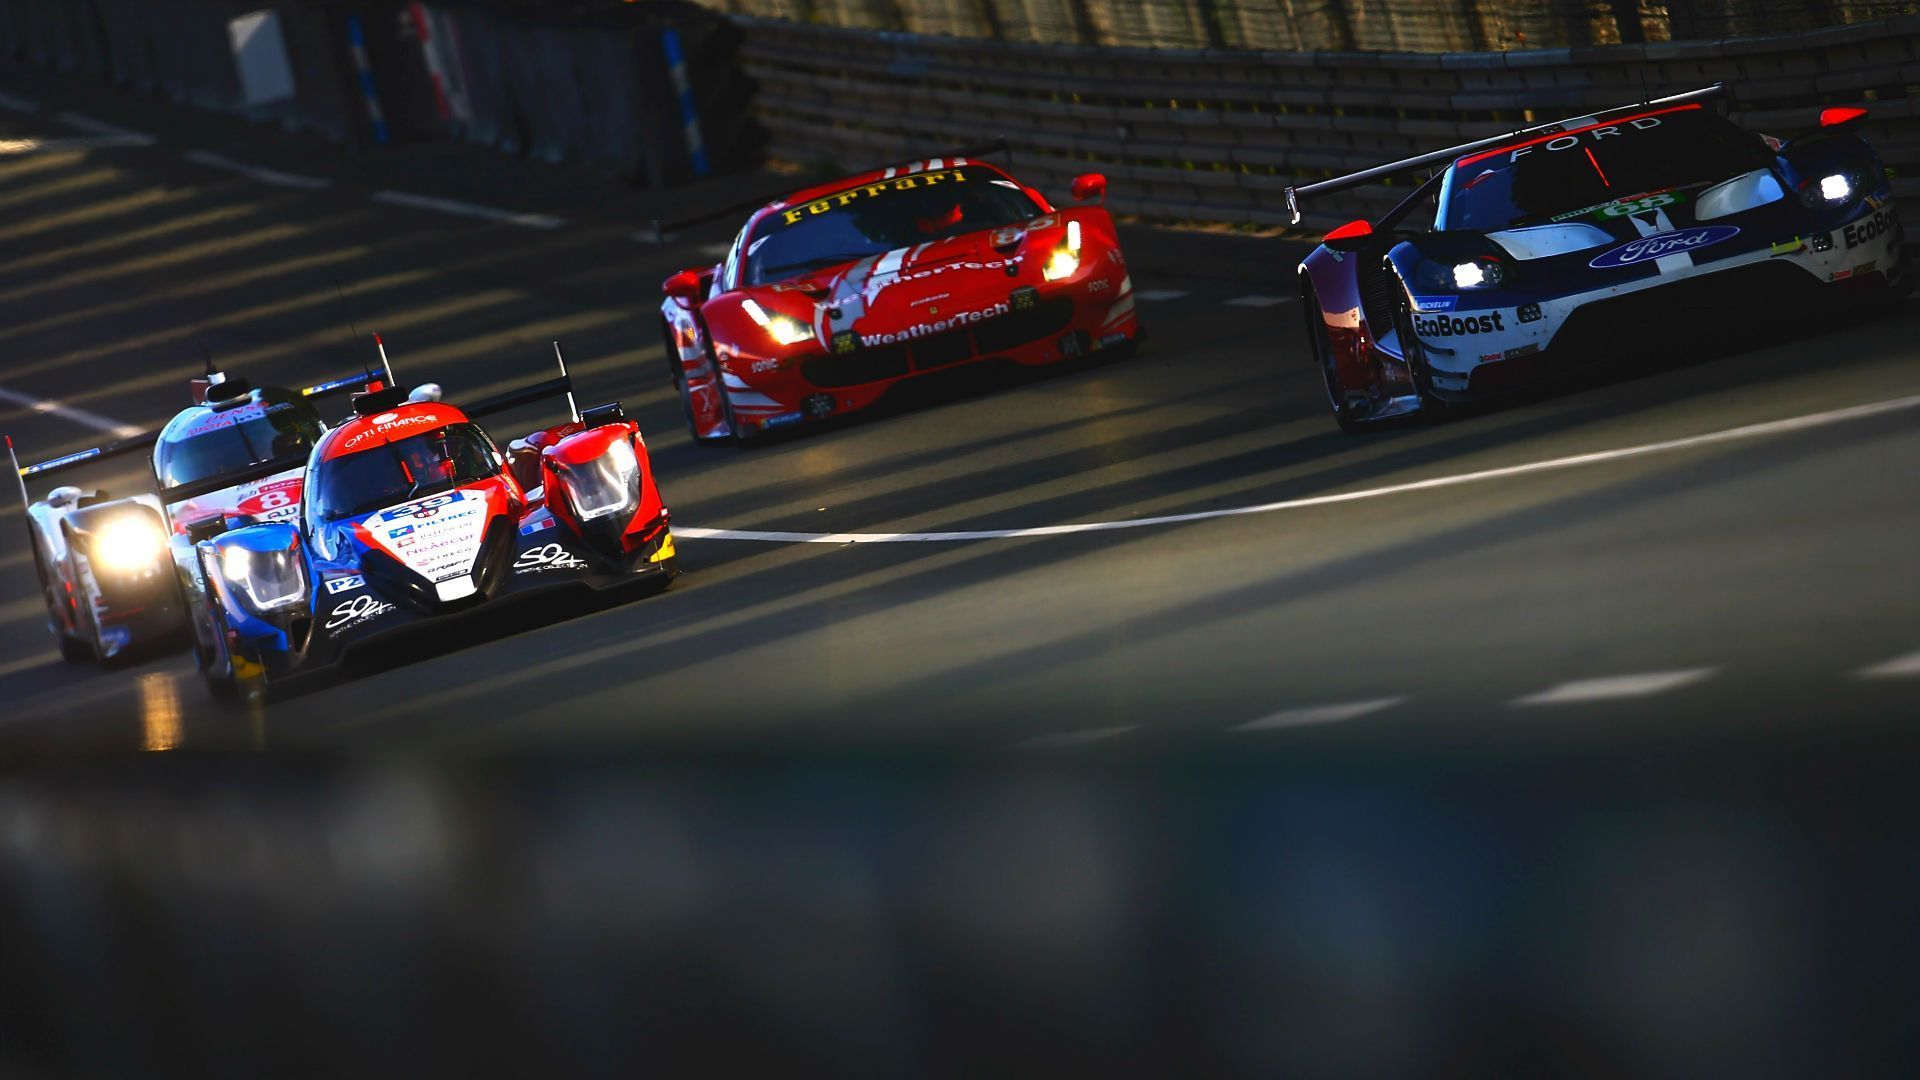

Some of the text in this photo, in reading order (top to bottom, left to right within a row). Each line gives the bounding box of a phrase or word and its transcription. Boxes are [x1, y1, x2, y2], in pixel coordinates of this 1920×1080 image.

[1510, 117, 1663, 163] FORD
[782, 169, 967, 226] Ferrari
[1602, 193, 1677, 217] 68
[1619, 231, 1709, 262] Ford
[861, 303, 1009, 347] WeatherTech
[1414, 311, 1505, 337] EcoBoost
[344, 414, 437, 448] OPTI FINANCE
[259, 490, 291, 510] 8
[418, 510, 477, 529] FILTREC
[331, 577, 361, 591] P2
